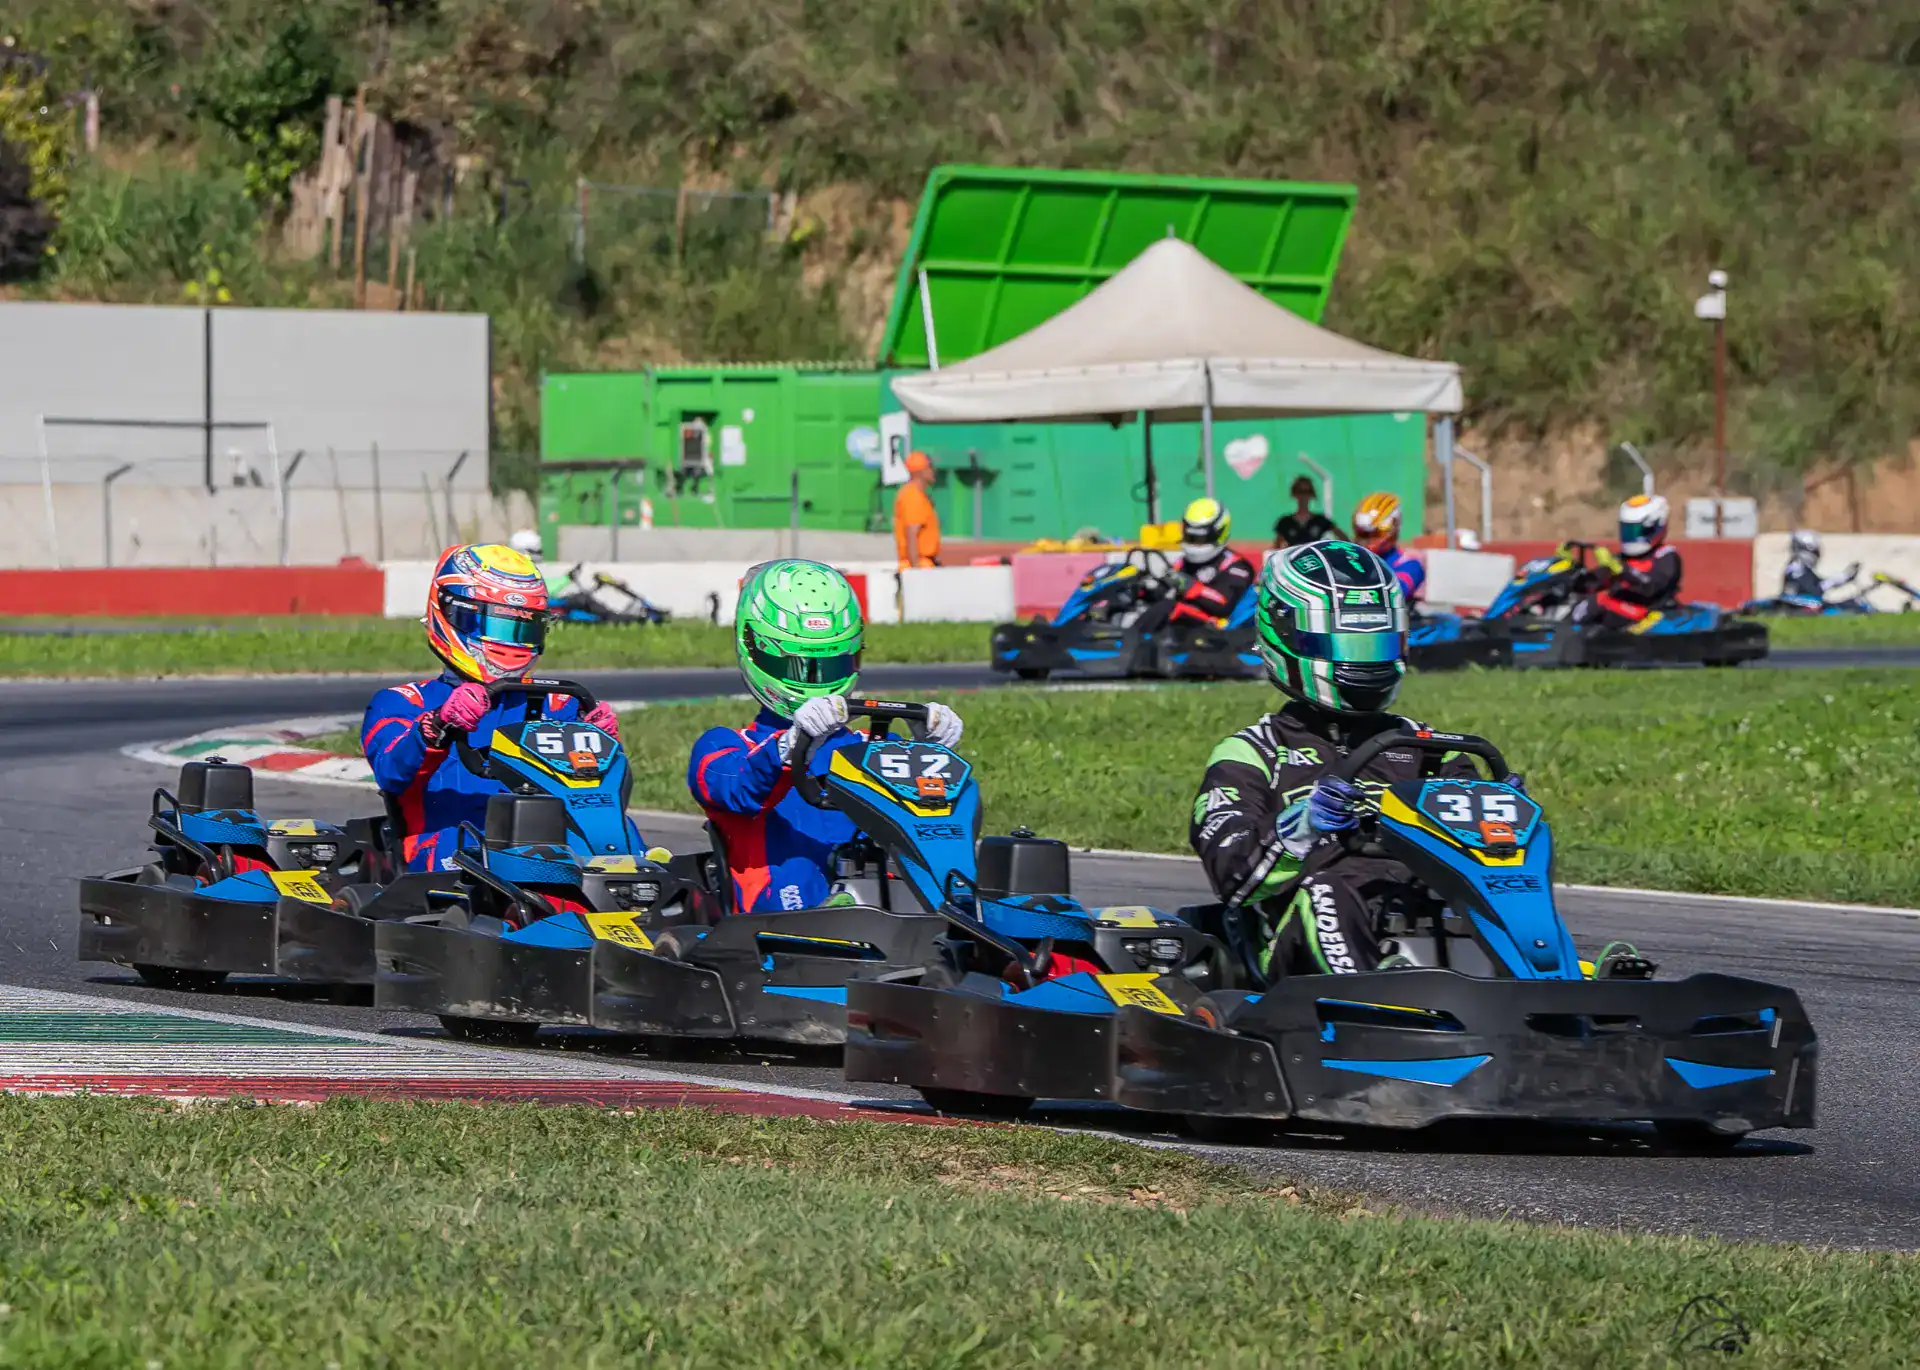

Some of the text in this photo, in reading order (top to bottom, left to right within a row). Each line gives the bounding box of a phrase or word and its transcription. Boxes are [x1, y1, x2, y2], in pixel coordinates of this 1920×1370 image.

[535, 732, 602, 754] 50
[879, 754, 952, 778] 52
[568, 797, 615, 807] KCE
[1436, 794, 1518, 822] 35
[916, 827, 966, 837] KCE
[1484, 879, 1542, 891] KCE
